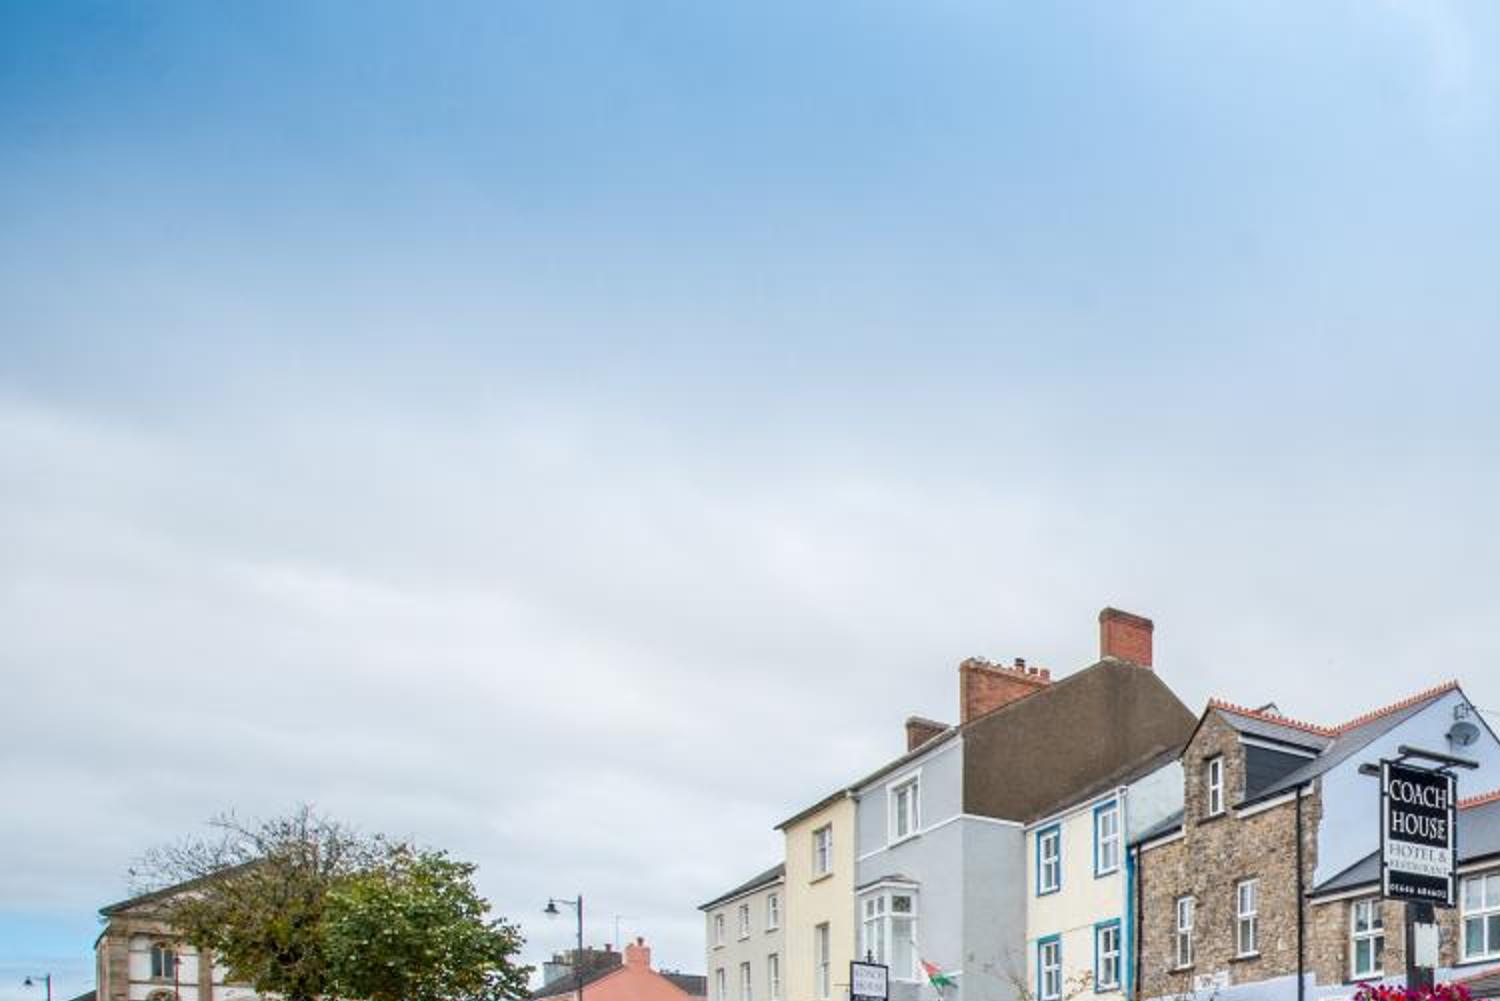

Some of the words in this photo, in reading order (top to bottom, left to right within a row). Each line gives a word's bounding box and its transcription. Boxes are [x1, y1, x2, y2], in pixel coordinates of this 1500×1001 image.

[1390, 779, 1447, 810] COACH
[1391, 809, 1446, 840] HOUSE
[1389, 842, 1436, 862] HOTEL
